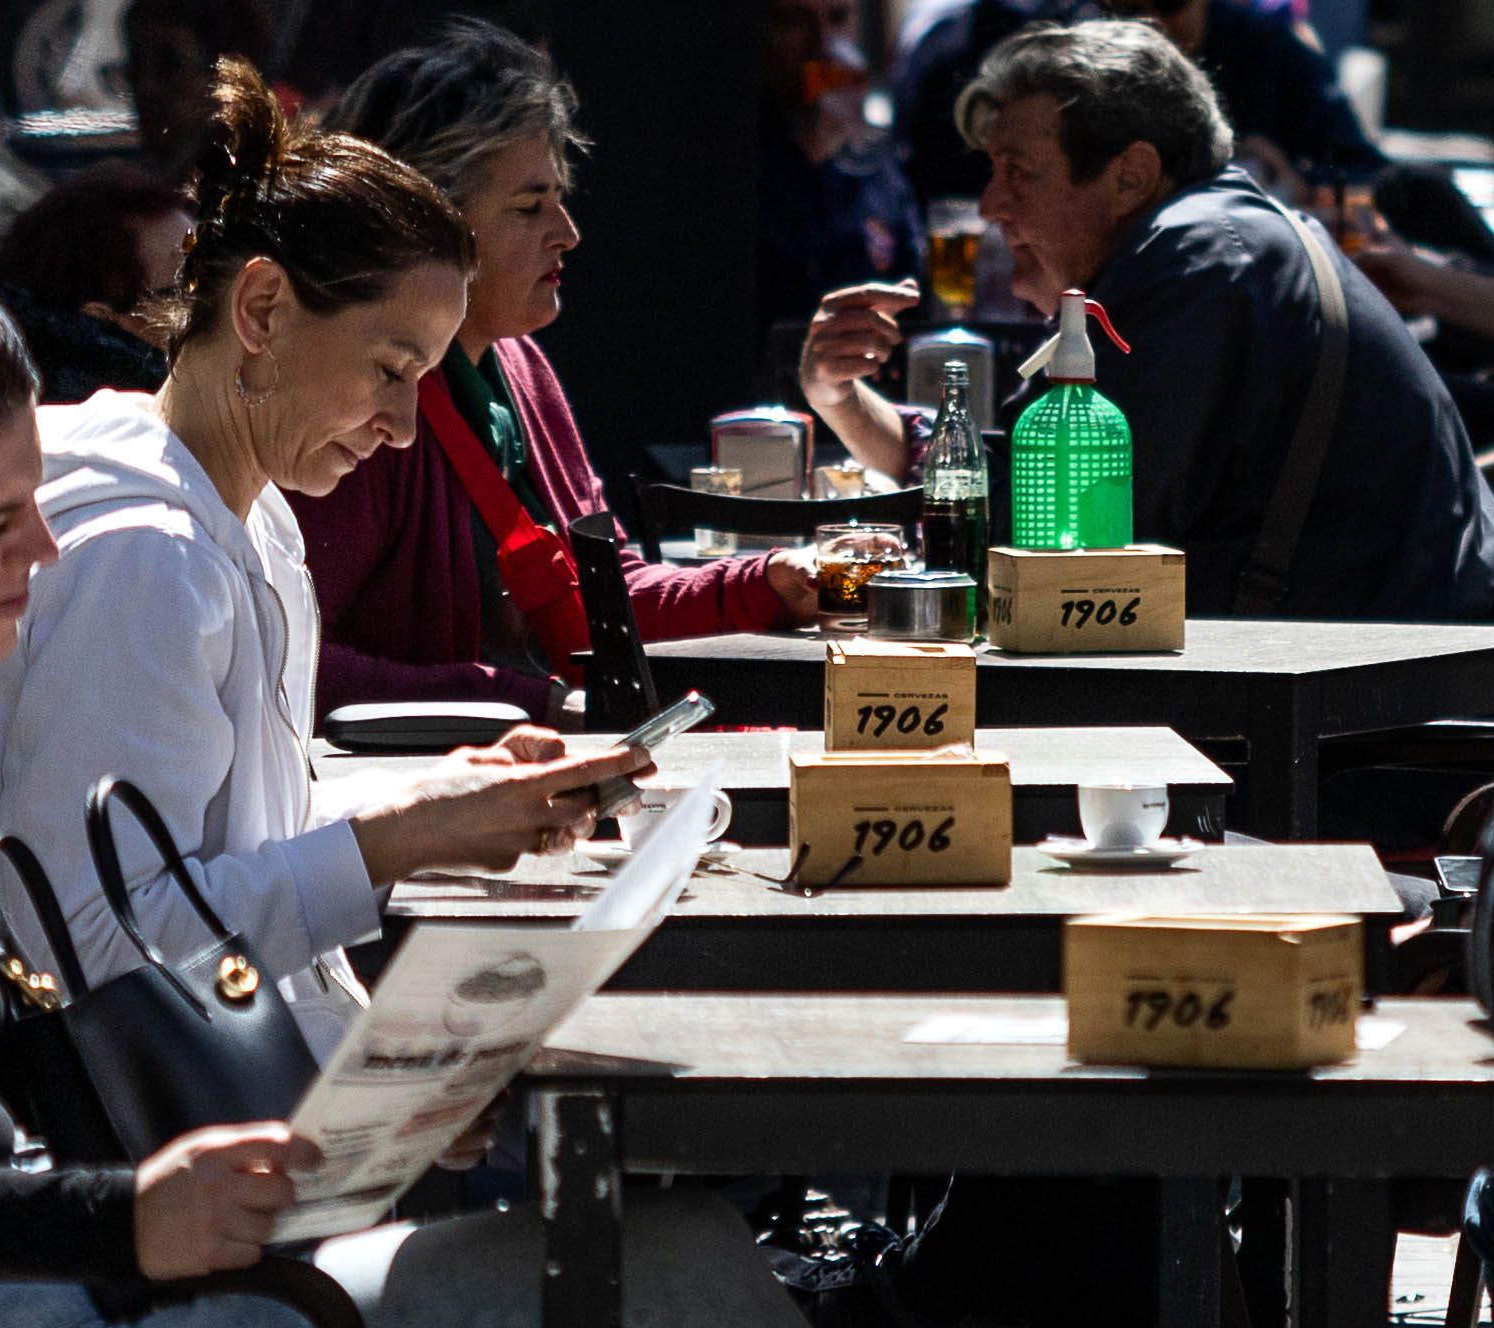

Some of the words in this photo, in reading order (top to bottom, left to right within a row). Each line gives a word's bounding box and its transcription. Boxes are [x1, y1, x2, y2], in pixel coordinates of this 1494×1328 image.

[1061, 597, 1141, 629] 1906
[857, 703, 949, 738] 1906
[854, 816, 955, 856] 1906
[1124, 989, 1236, 1031] 1906
